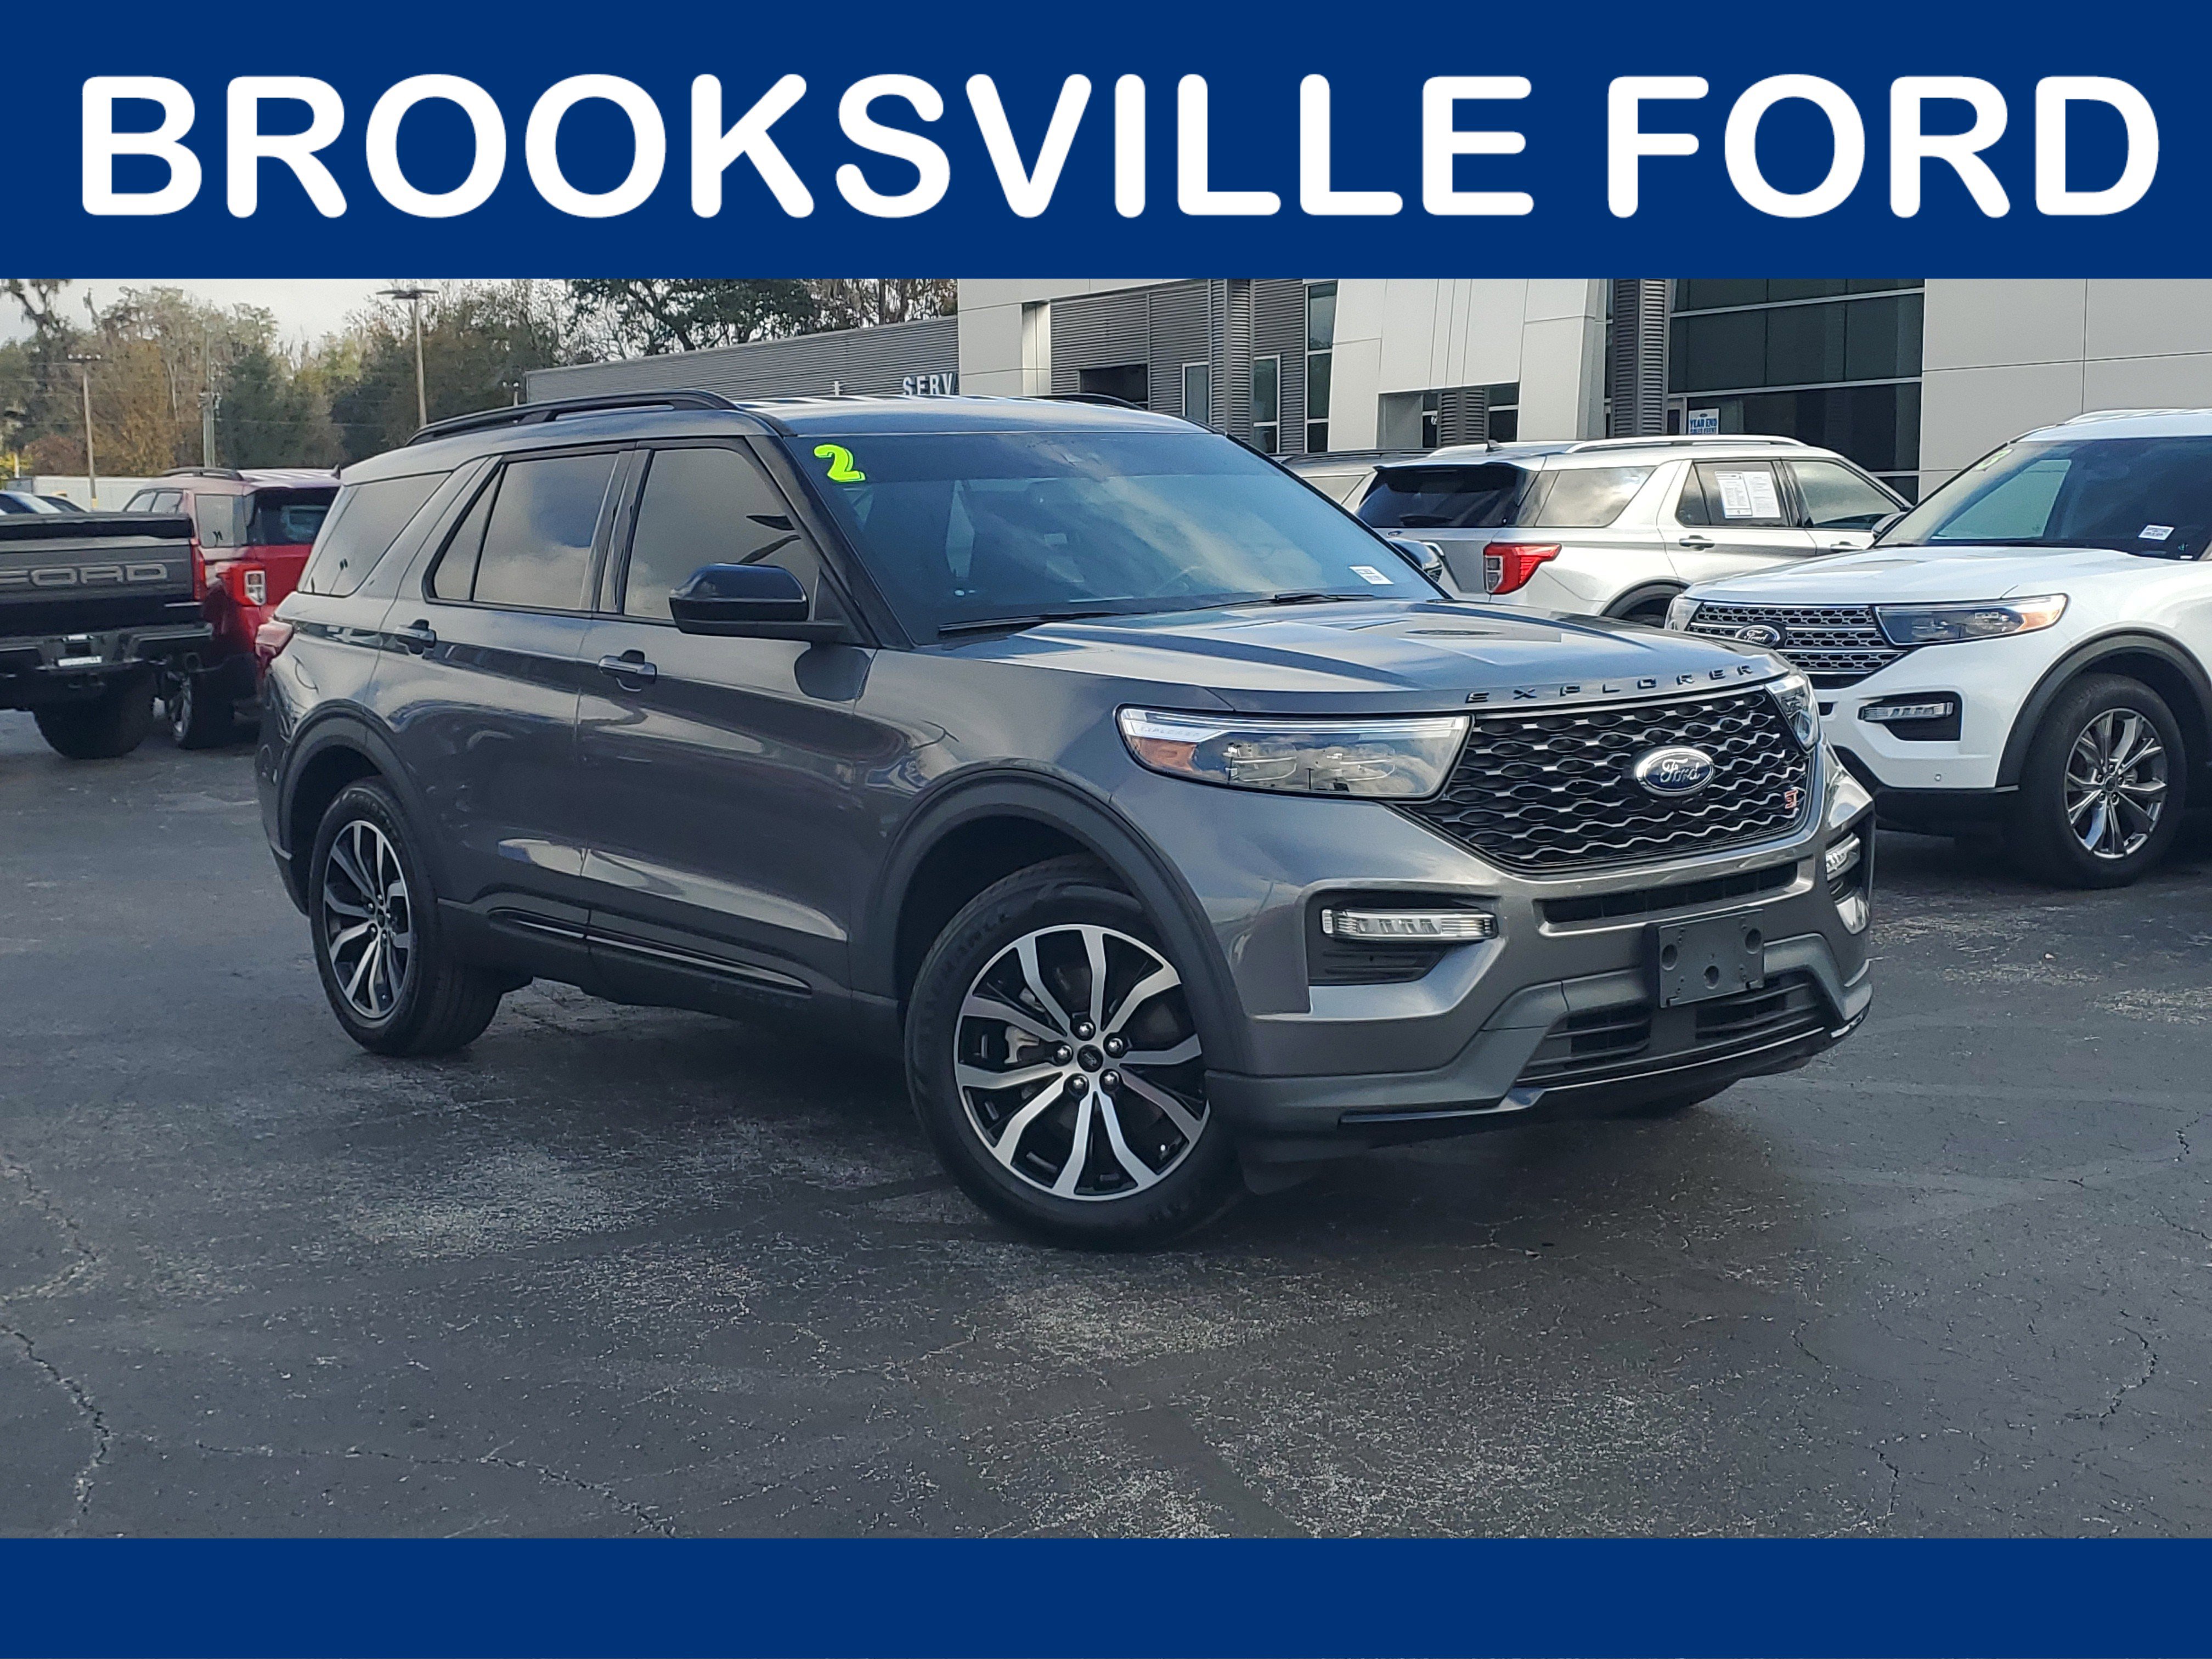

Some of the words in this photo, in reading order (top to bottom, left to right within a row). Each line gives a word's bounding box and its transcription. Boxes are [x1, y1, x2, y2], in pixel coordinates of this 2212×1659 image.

[902, 373, 953, 395] SERV
[814, 444, 866, 482] 2
[1465, 665, 1753, 703] EXPLORER
[1660, 758, 1700, 783] Ford
